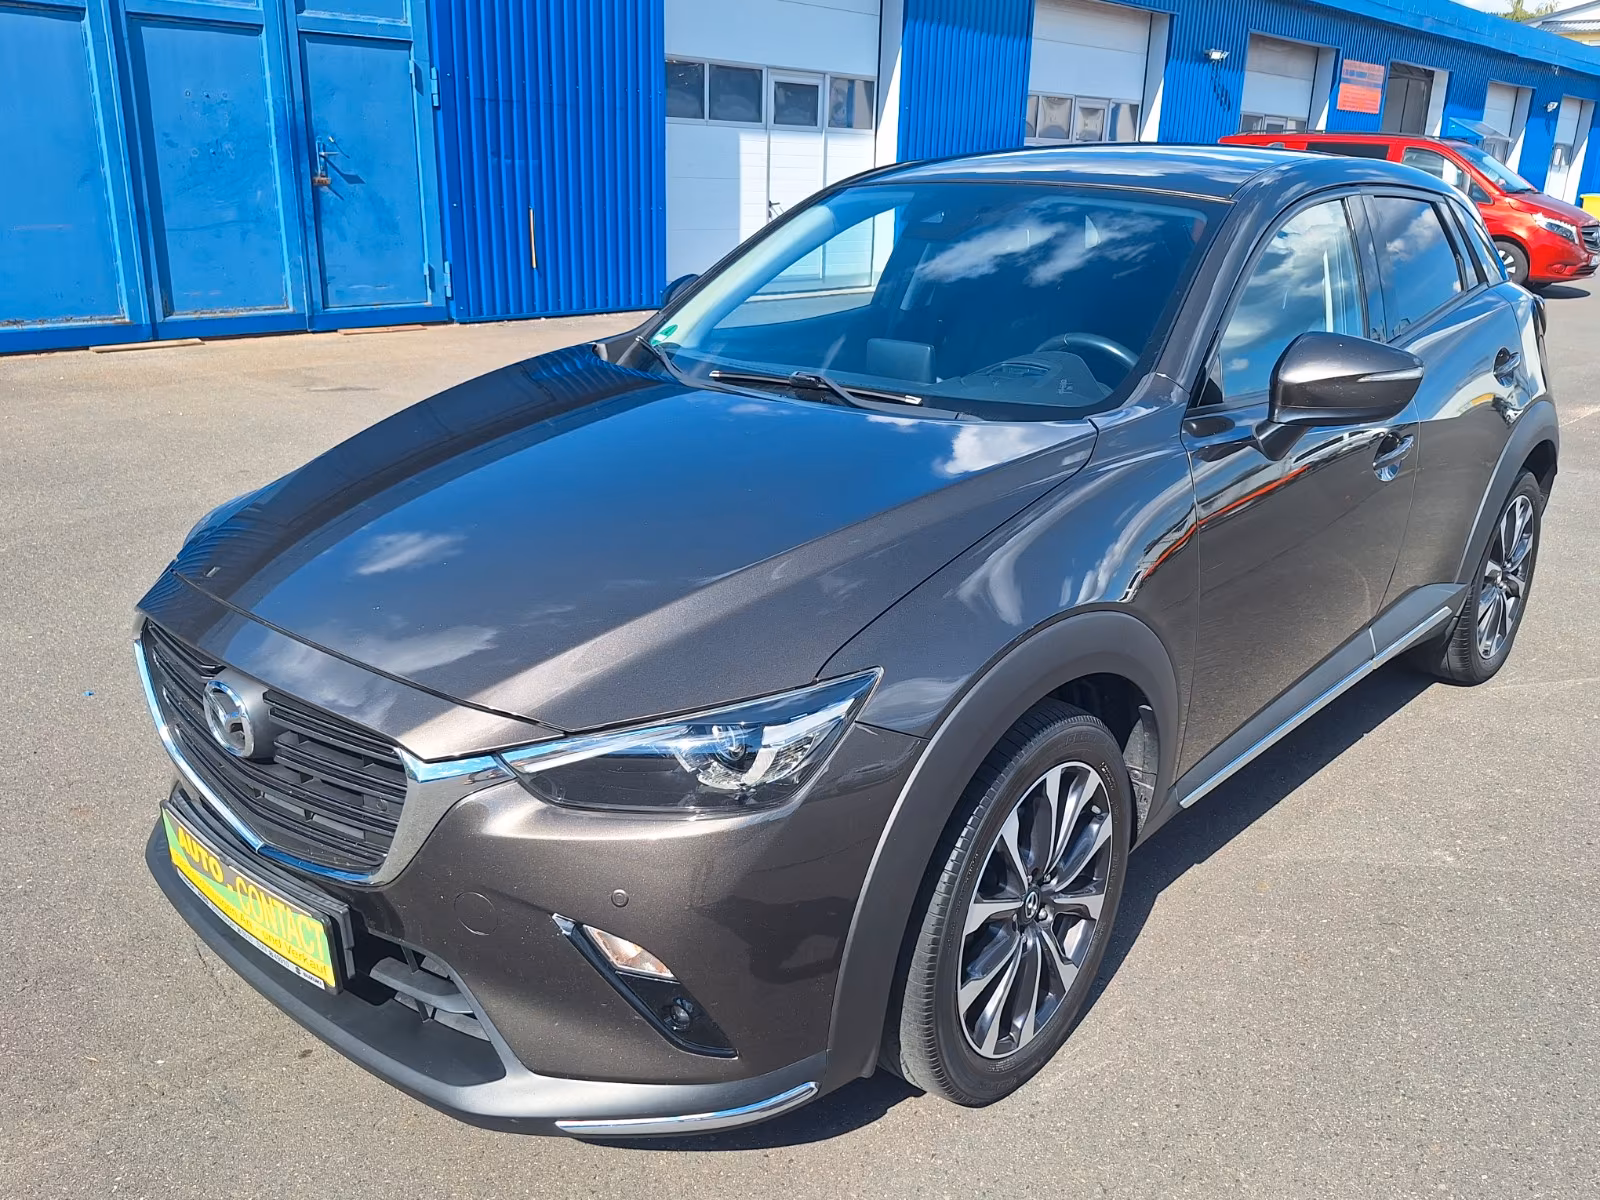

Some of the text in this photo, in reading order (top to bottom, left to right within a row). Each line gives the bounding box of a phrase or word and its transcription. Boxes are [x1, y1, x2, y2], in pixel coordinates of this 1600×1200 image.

[178, 826, 224, 883] AUTO
[236, 876, 326, 961] CONTACT
[262, 931, 282, 949] und
[284, 941, 328, 977] Verkauf
